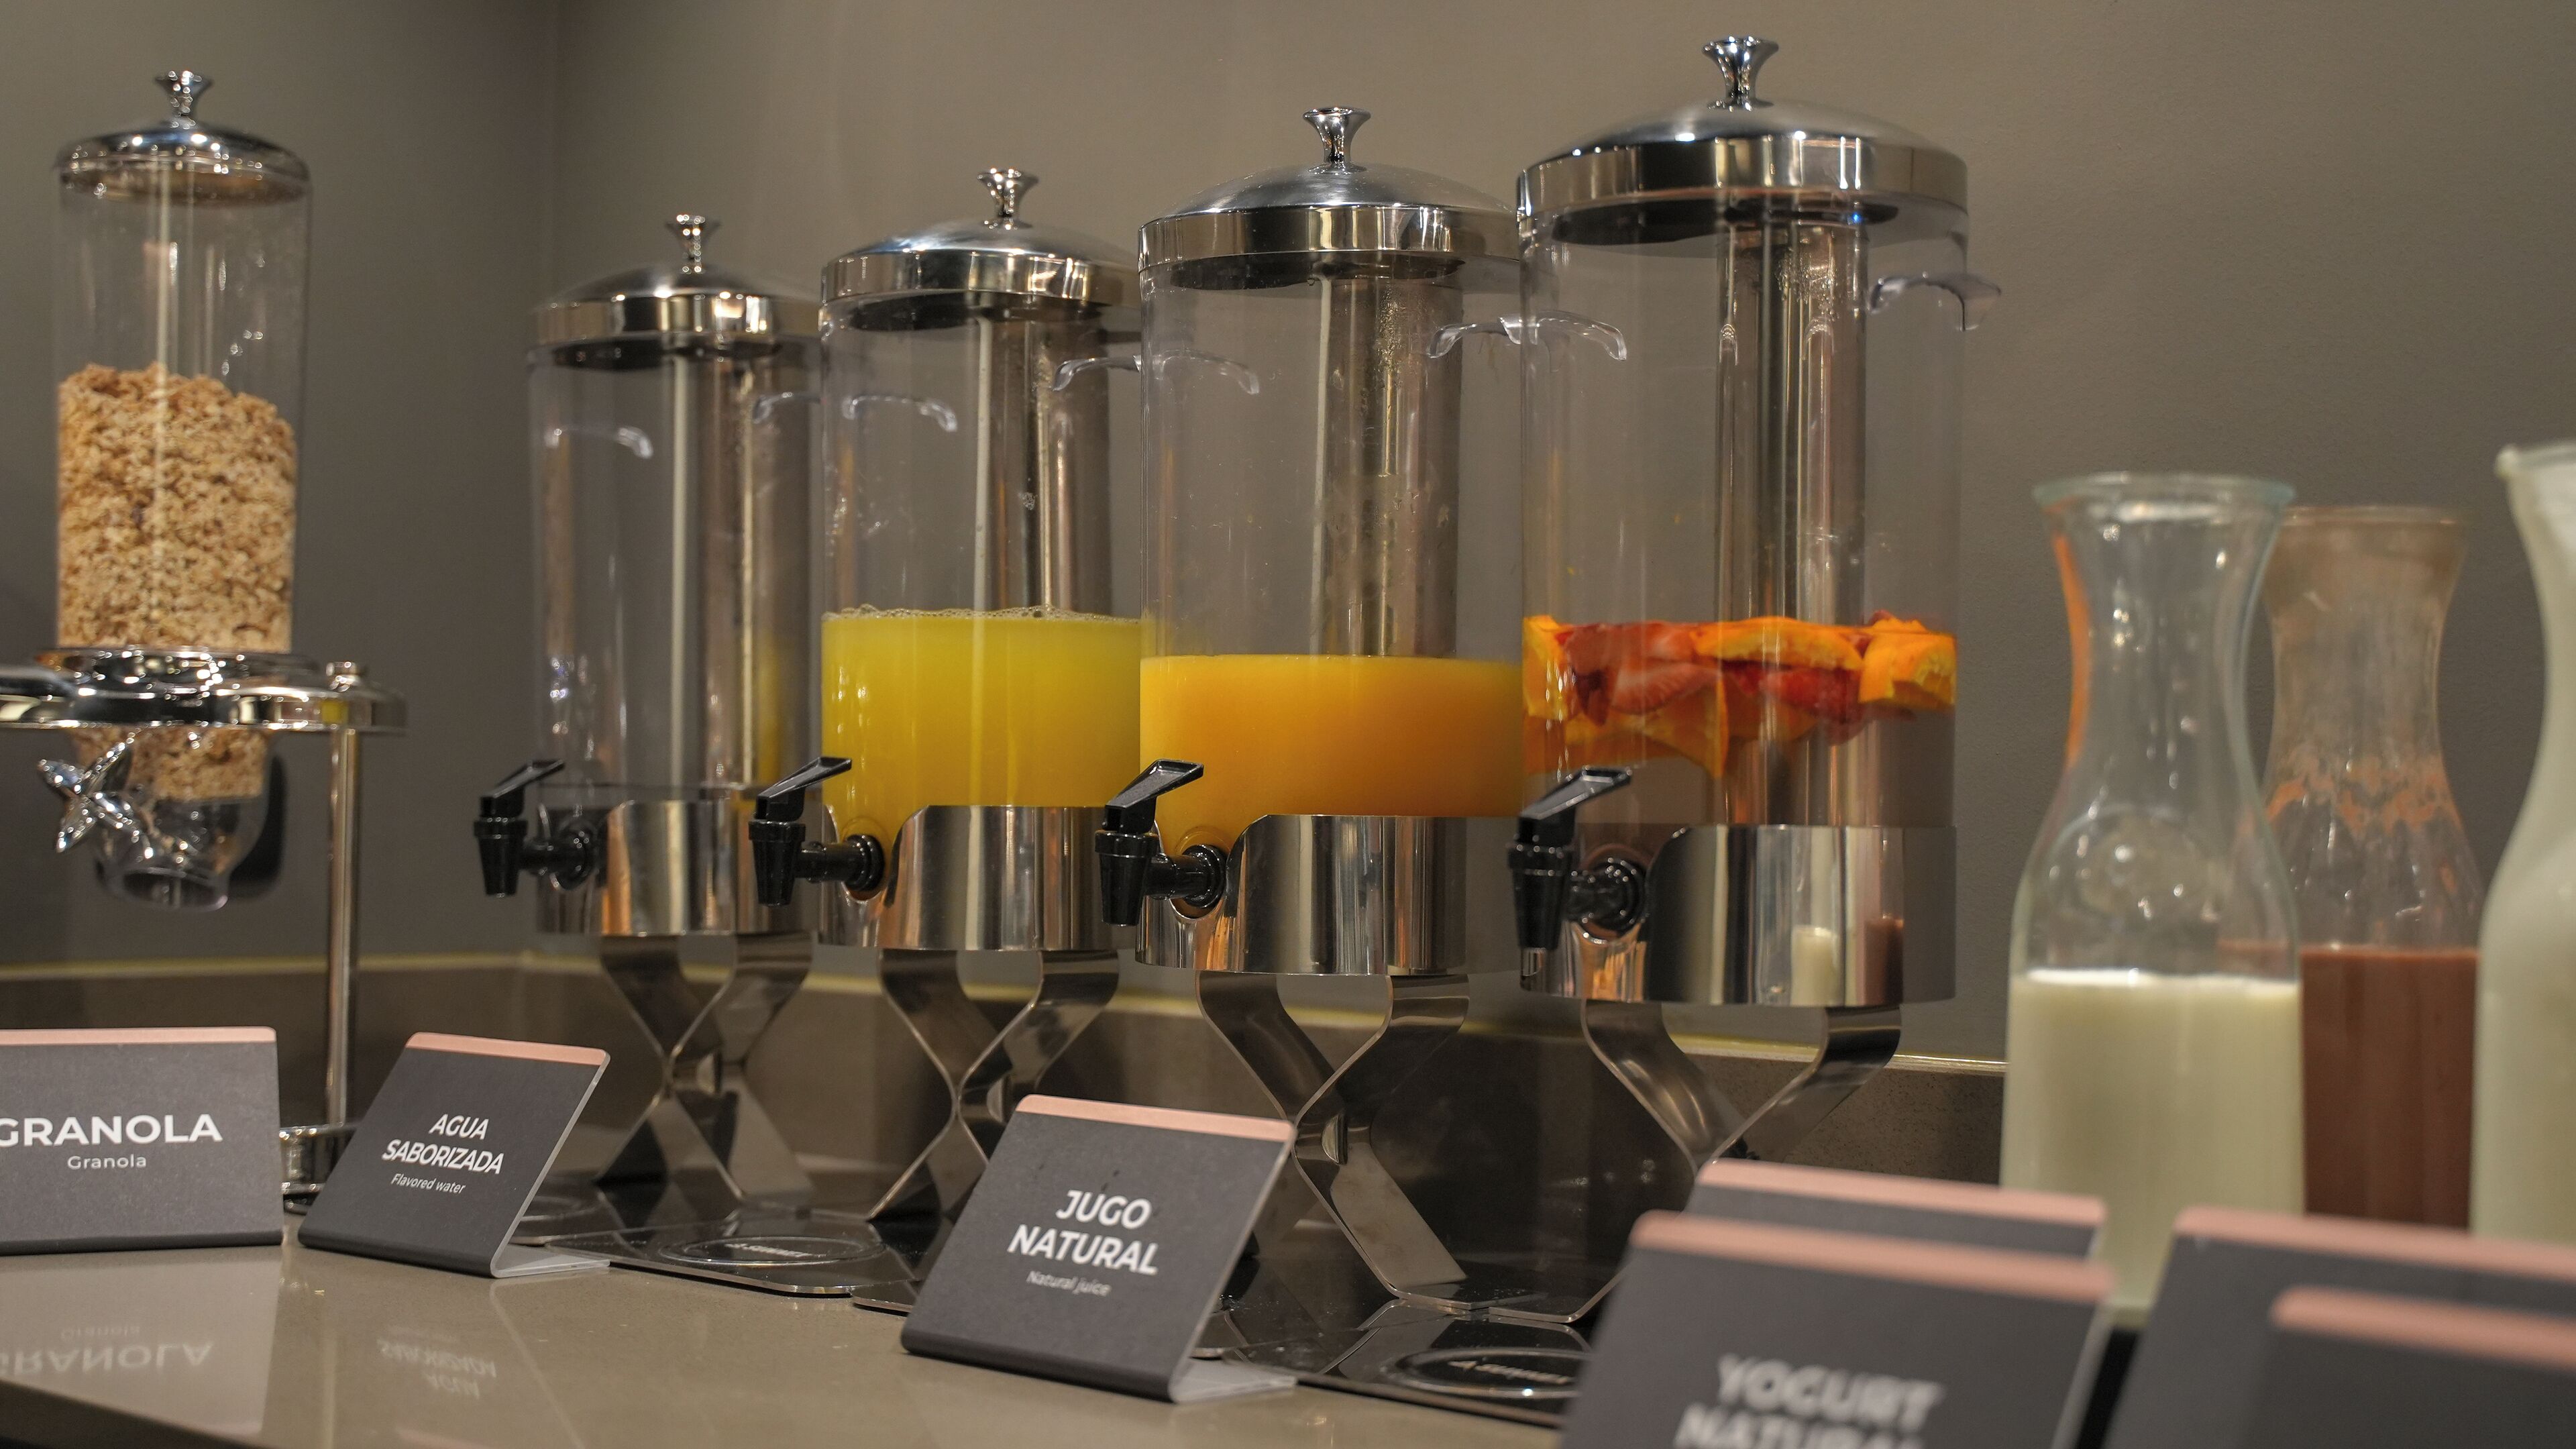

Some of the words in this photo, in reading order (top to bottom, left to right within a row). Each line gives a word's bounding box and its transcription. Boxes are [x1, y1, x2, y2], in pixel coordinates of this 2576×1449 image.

[0, 1114, 223, 1148] GRANOLA
[428, 1113, 490, 1140] AGUA
[67, 1154, 147, 1170] Granola
[382, 1139, 504, 1175] SABORIZADA
[390, 1173, 437, 1190] Flavored
[436, 1180, 466, 1194] water
[1055, 1189, 1152, 1230] JUGO
[1007, 1224, 1159, 1276] NATURAL
[1026, 1271, 1079, 1289] Natural
[1073, 1277, 1112, 1297] juice
[1717, 1352, 1945, 1434] YOGURT
[1673, 1402, 1925, 1449] NATU
